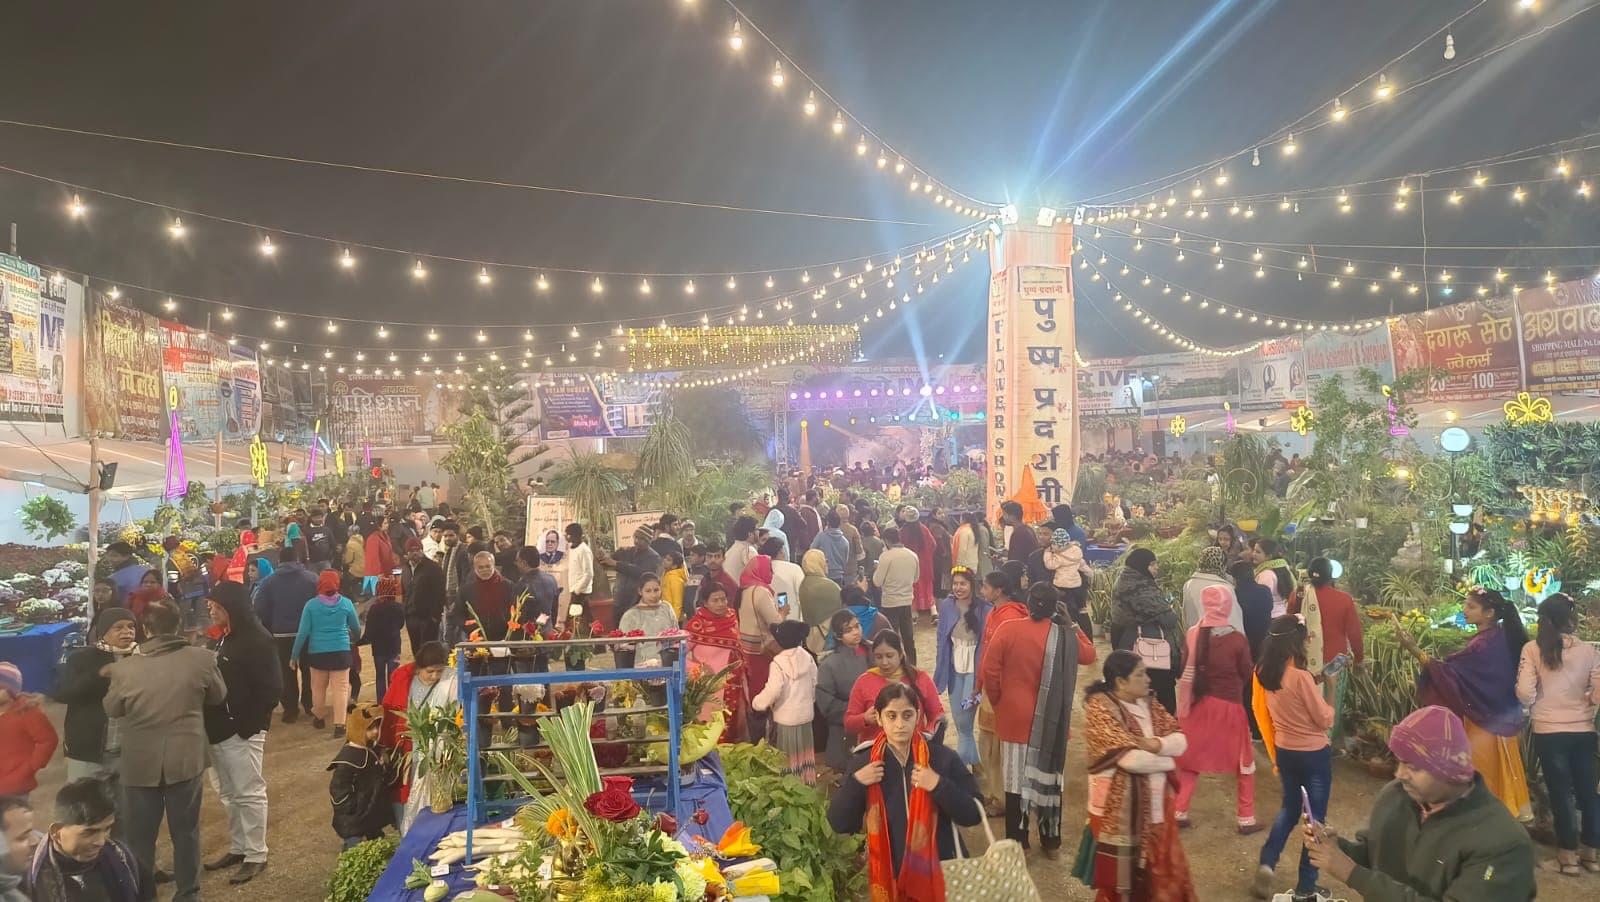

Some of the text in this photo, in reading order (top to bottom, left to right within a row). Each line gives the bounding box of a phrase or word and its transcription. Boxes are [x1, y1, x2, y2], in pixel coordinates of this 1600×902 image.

[1477, 313, 1512, 345] सेठ
[1446, 348, 1493, 370] ज्वेलर्स
[1098, 369, 1137, 387] IVF
[994, 319, 1006, 497] FLOWER SHOW
